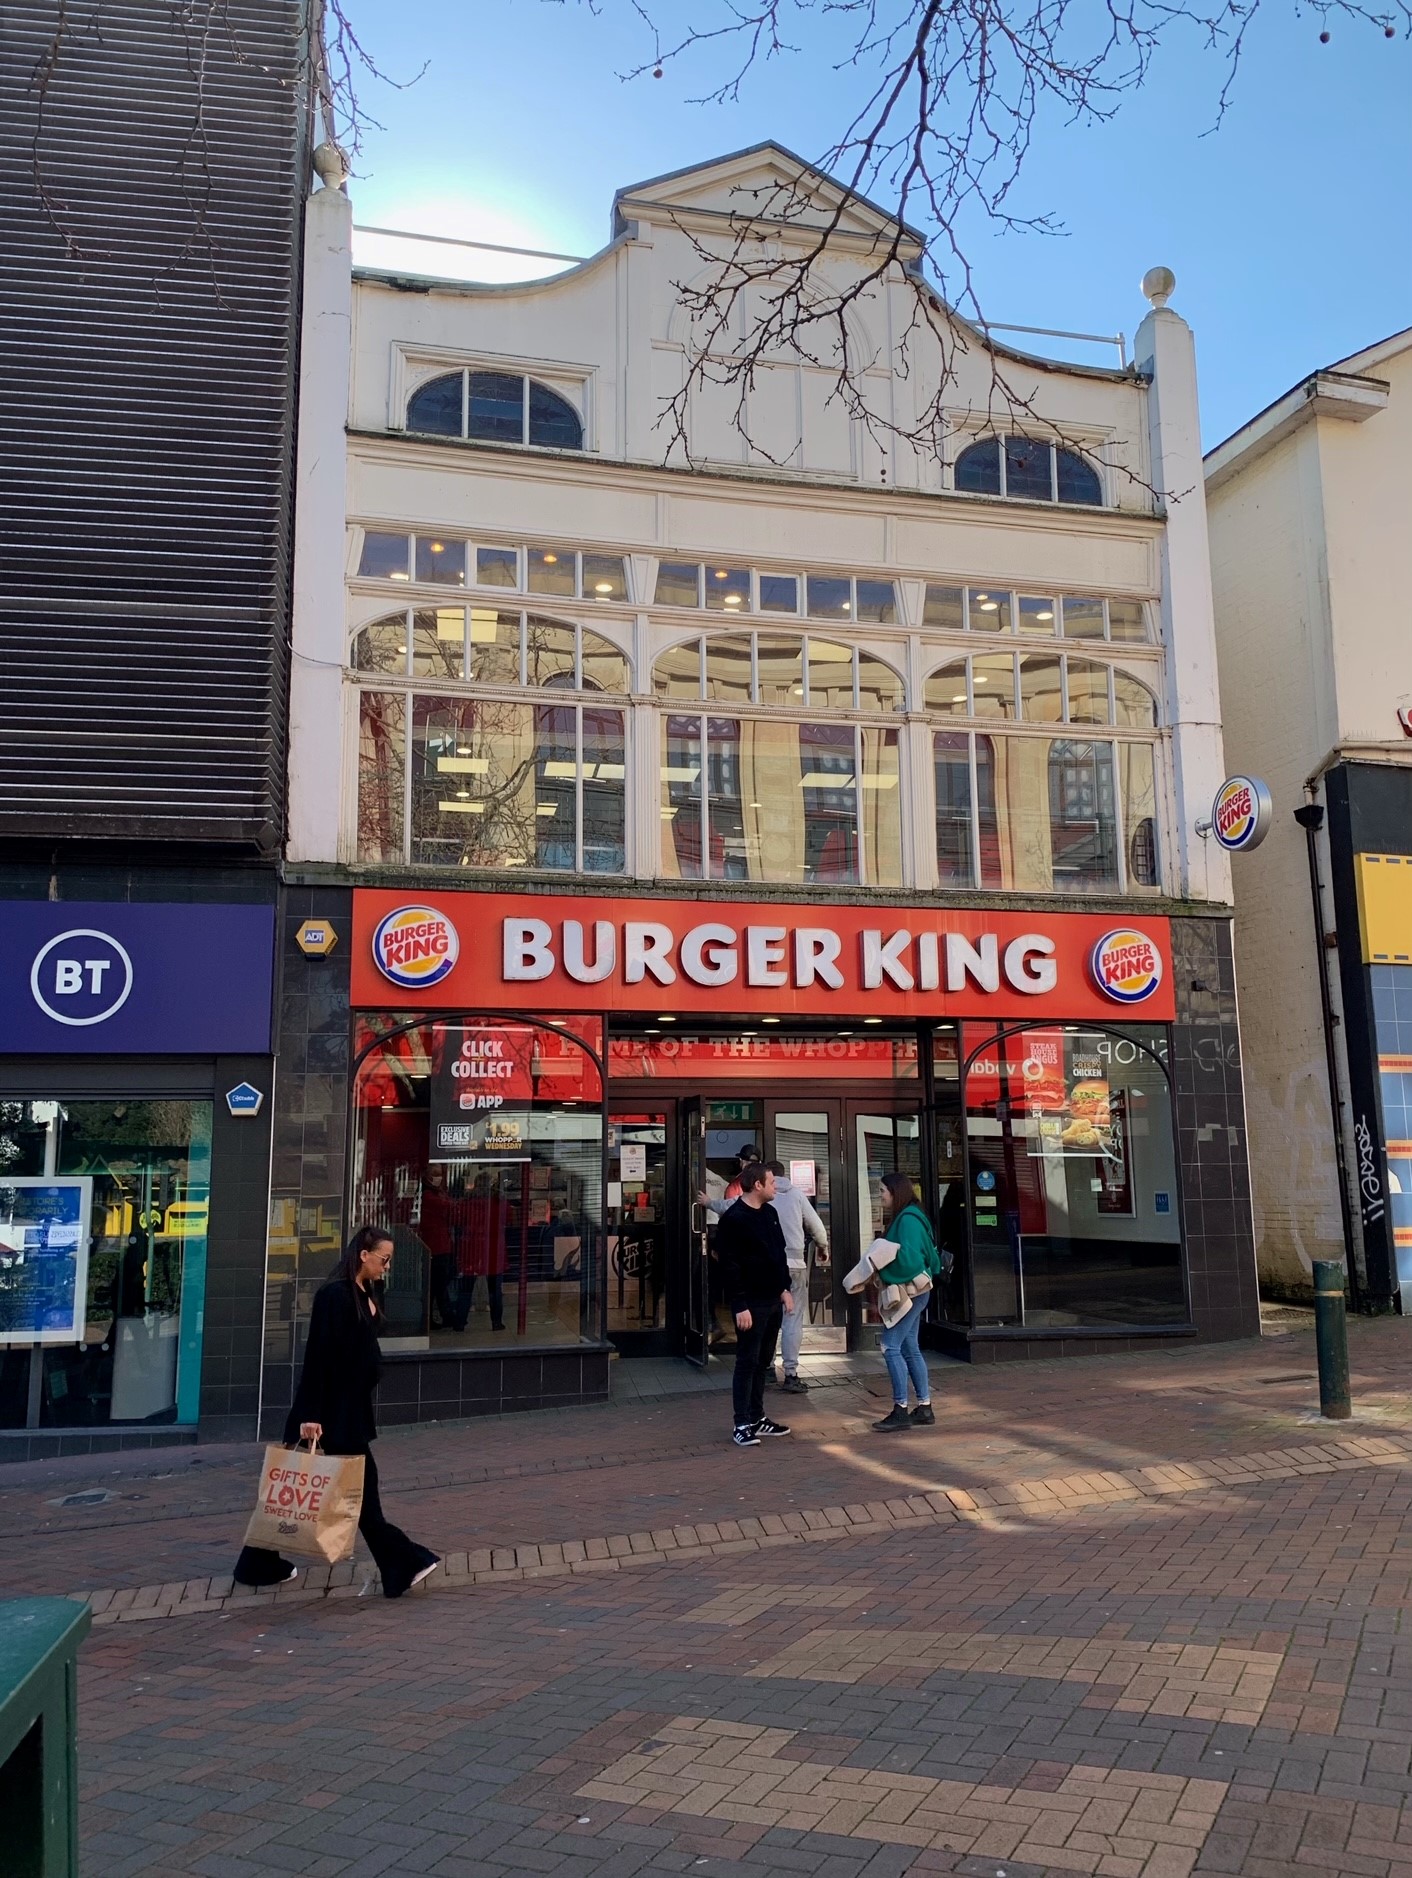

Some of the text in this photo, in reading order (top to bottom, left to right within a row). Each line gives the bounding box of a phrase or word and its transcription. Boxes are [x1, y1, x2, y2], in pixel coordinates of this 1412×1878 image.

[1217, 787, 1249, 821] BURGER
[1220, 799, 1251, 837] KING
[305, 932, 324, 942] ADT
[383, 921, 446, 949] BURGER
[386, 934, 449, 969] KING
[501, 917, 1058, 995] BURGER KING
[1102, 943, 1152, 967] BURGER
[55, 959, 111, 995] BT
[1105, 955, 1155, 985] KING
[462, 1041, 503, 1057] CLICK
[659, 1037, 699, 1057] OF
[709, 1037, 770, 1057] THE
[451, 1061, 514, 1078] COLLECT
[1073, 1068, 1102, 1077] CHICKEN
[477, 1095, 503, 1108] APP
[440, 1132, 470, 1142] DEALS
[485, 1121, 520, 1137] £1.99
[484, 1142, 522, 1150] WEDNESDAY
[269, 1468, 331, 1489] GIFTS OF
[266, 1484, 323, 1512] LOVE
[264, 1505, 319, 1523] SWEET LOVE
